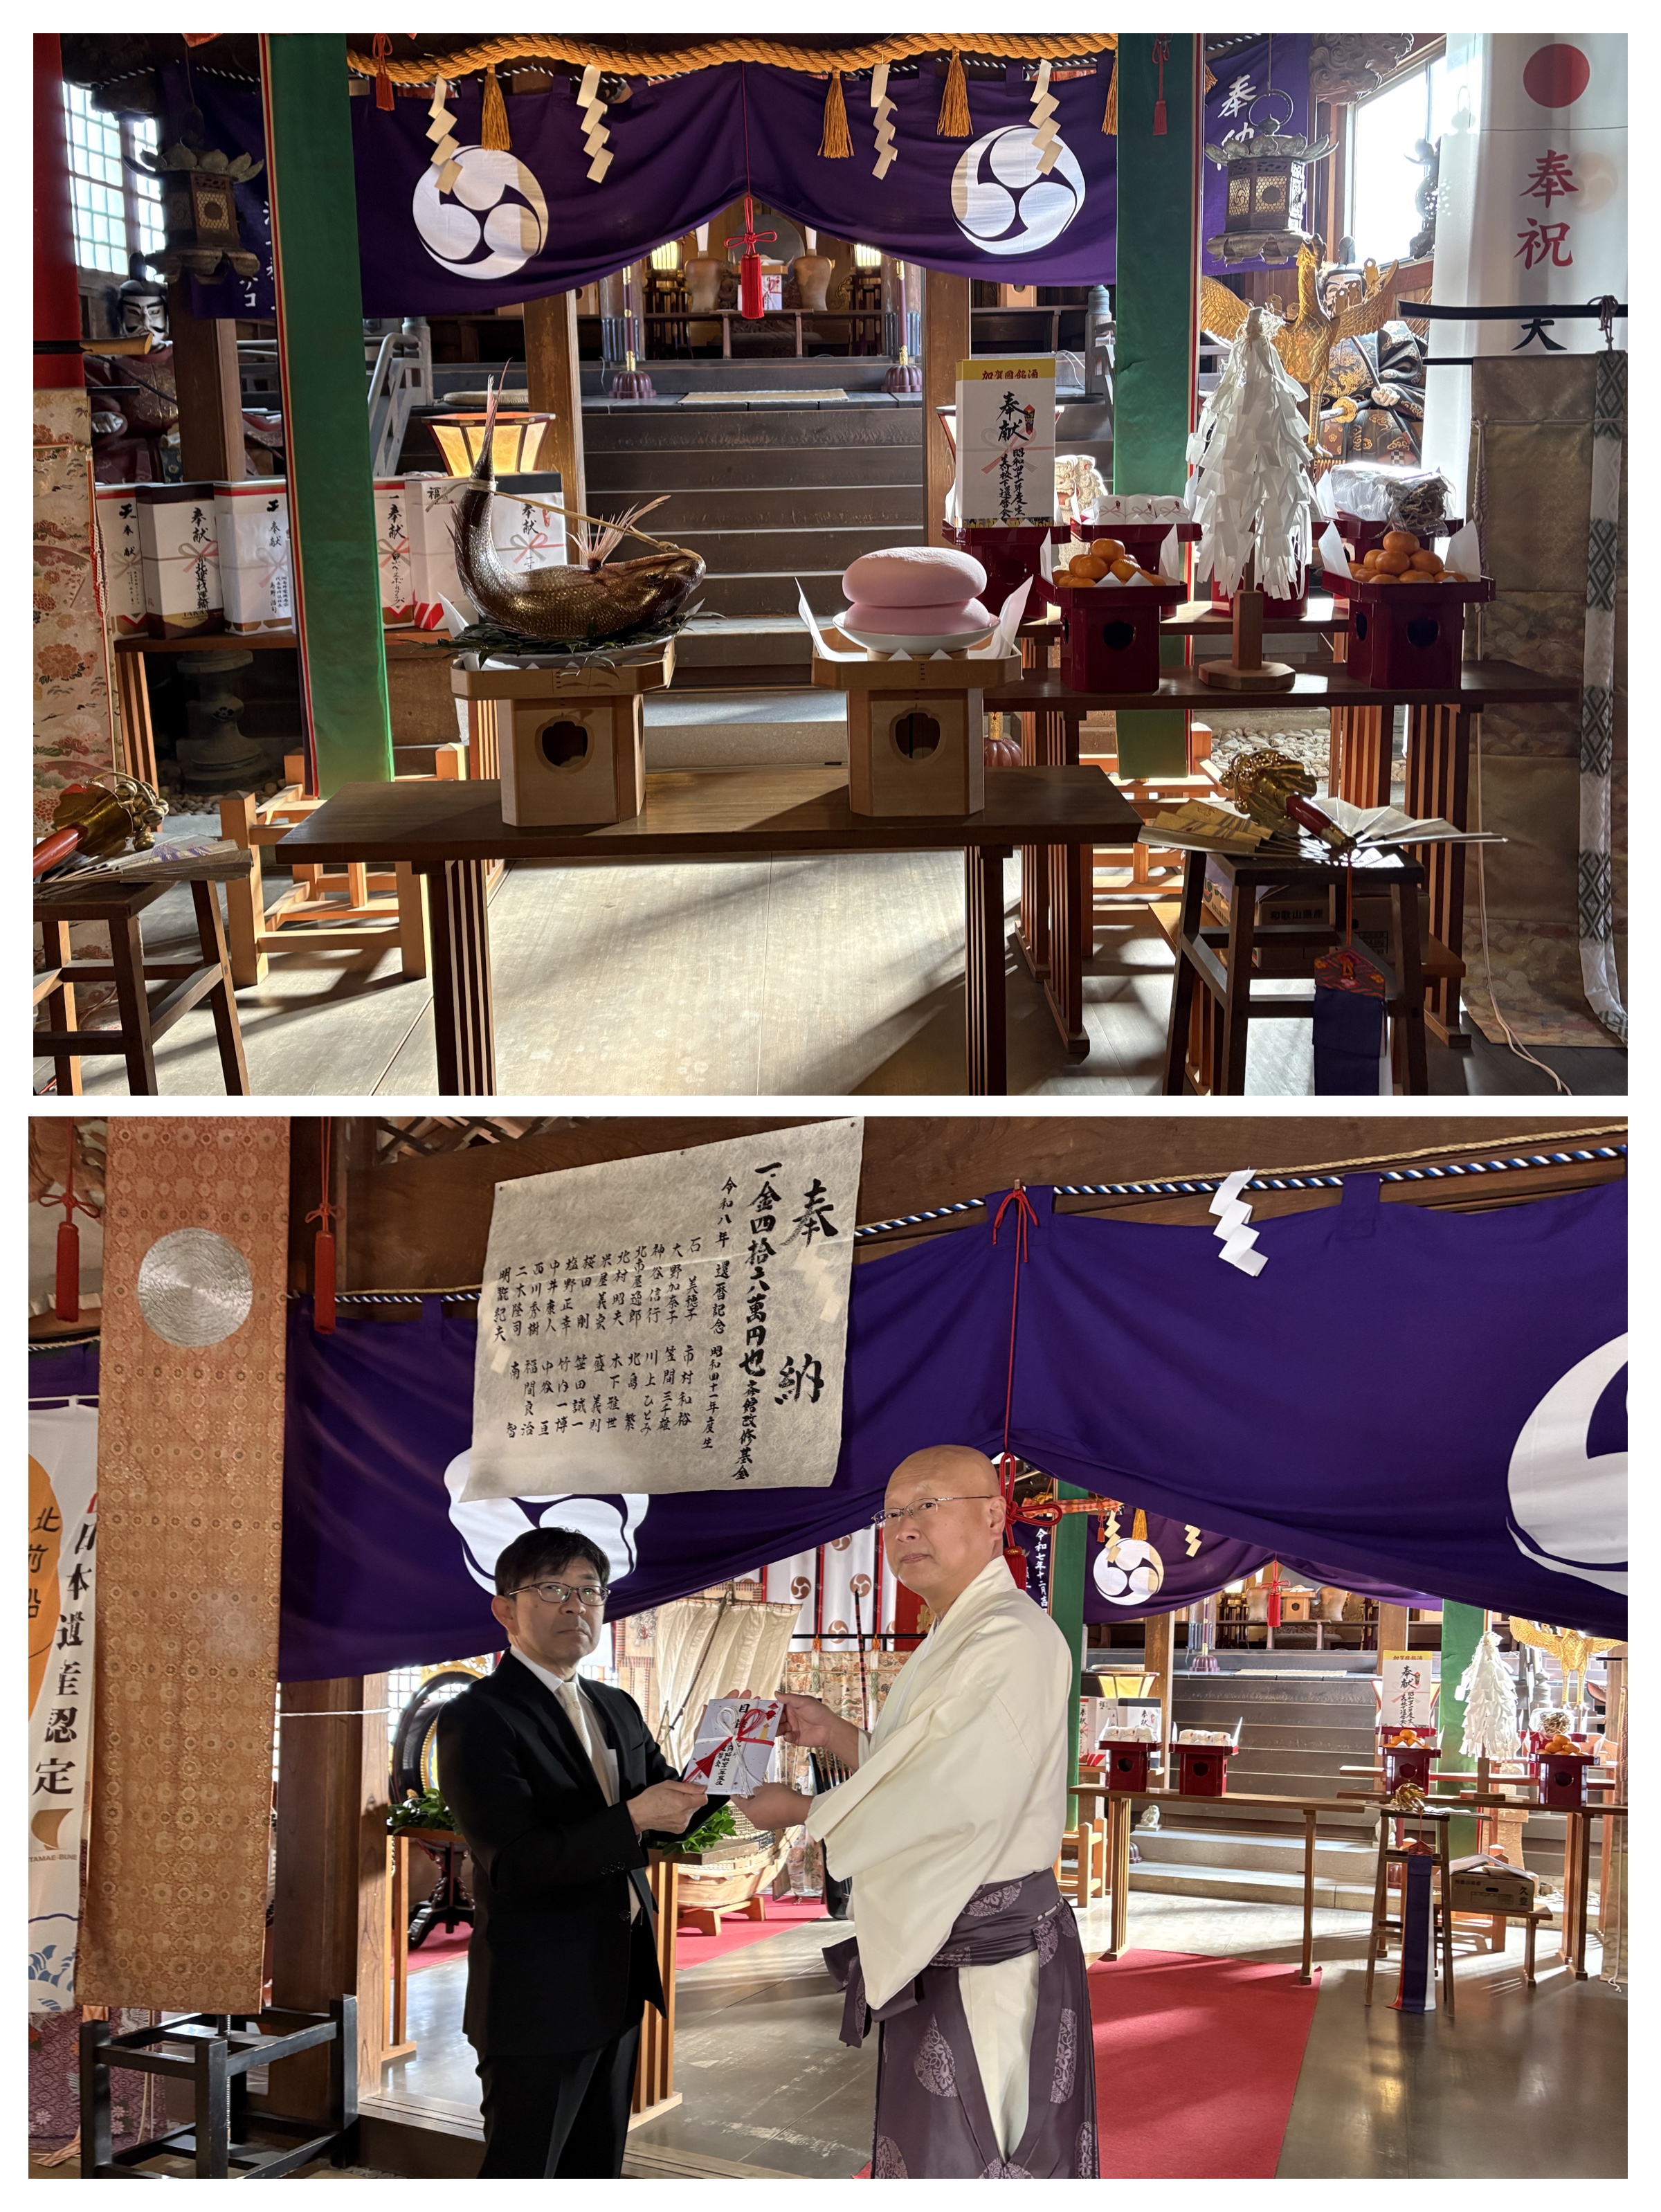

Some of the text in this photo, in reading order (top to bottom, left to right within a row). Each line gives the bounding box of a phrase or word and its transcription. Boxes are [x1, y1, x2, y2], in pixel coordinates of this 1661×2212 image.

[1514, 149, 1579, 271] 奉祝
[982, 369, 1038, 380] 加賀國銘酒
[996, 391, 1031, 442] 奉献
[1010, 447, 1028, 516] 昭和四十一年度生
[122, 525, 136, 556] 奉献
[191, 507, 211, 543] 奉献
[269, 520, 282, 547] 奉献
[388, 504, 406, 539] 奉献
[522, 503, 539, 535] 奉献
[1271, 909, 1323, 921] 和歌山県産
[511, 1266, 527, 1336] 二木隆司
[545, 1260, 560, 1332] 中井康人
[665, 1243, 683, 1325] 大野加奈子
[702, 1177, 737, 1449] 令和八年 還暦記念 昭和四十一年度生
[774, 1178, 838, 1405] 奉納
[521, 1262, 544, 1436] 西川秀樹 福間良治
[555, 1256, 578, 1433] 塩野正幸 竹内一博
[606, 1250, 630, 1429] 北村昭夫 木下雅世
[640, 1244, 664, 1436] 神谷信行 川上ひとみ
[572, 1354, 588, 1426] 笹田誠一
[674, 1345, 694, 1426] 市村和裕
[32, 1523, 98, 1796] 日本遺産認定
[1399, 1665, 1417, 1689] 奉献
